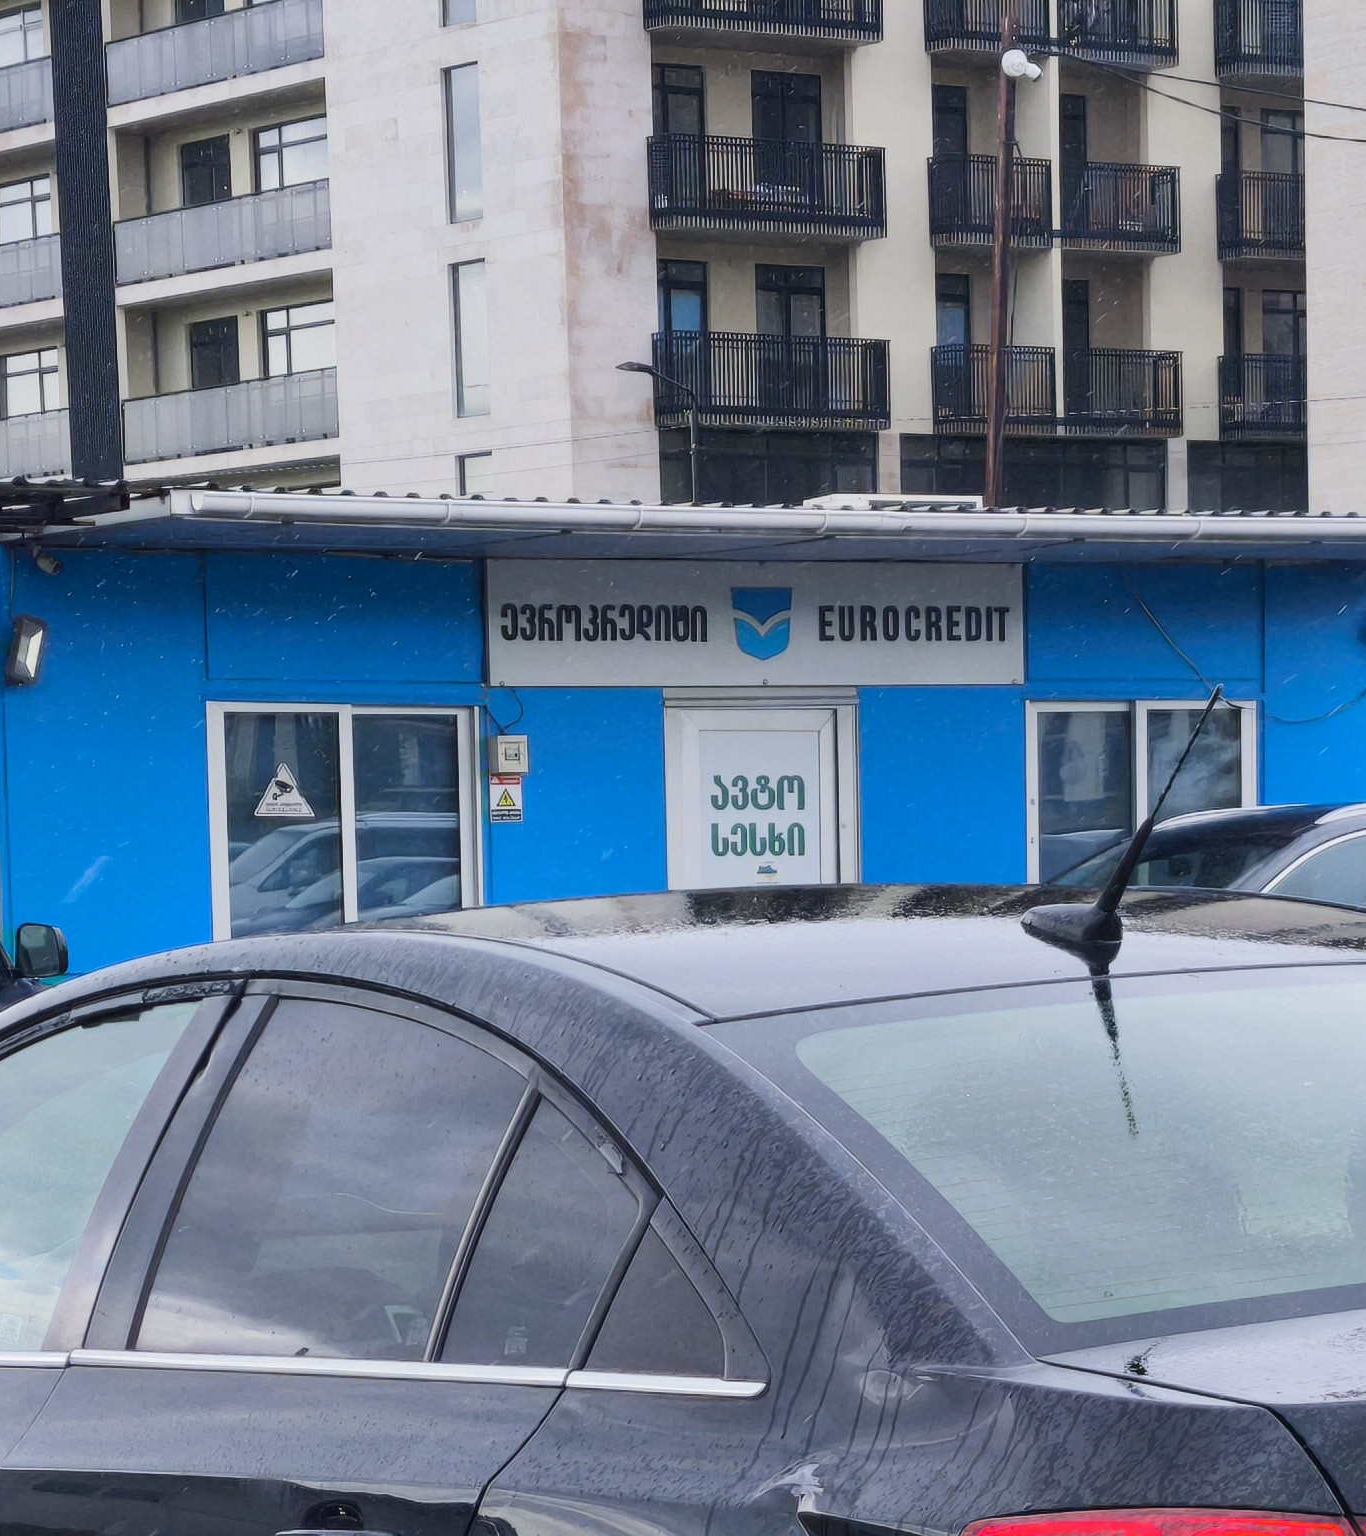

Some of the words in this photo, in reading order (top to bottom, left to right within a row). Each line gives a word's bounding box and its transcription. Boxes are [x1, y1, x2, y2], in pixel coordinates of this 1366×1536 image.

[500, 602, 708, 643] ევროკრედიტი
[818, 604, 1010, 642] EUROCREDIT
[710, 774, 805, 811] ავტო
[710, 822, 806, 857] სესხი
